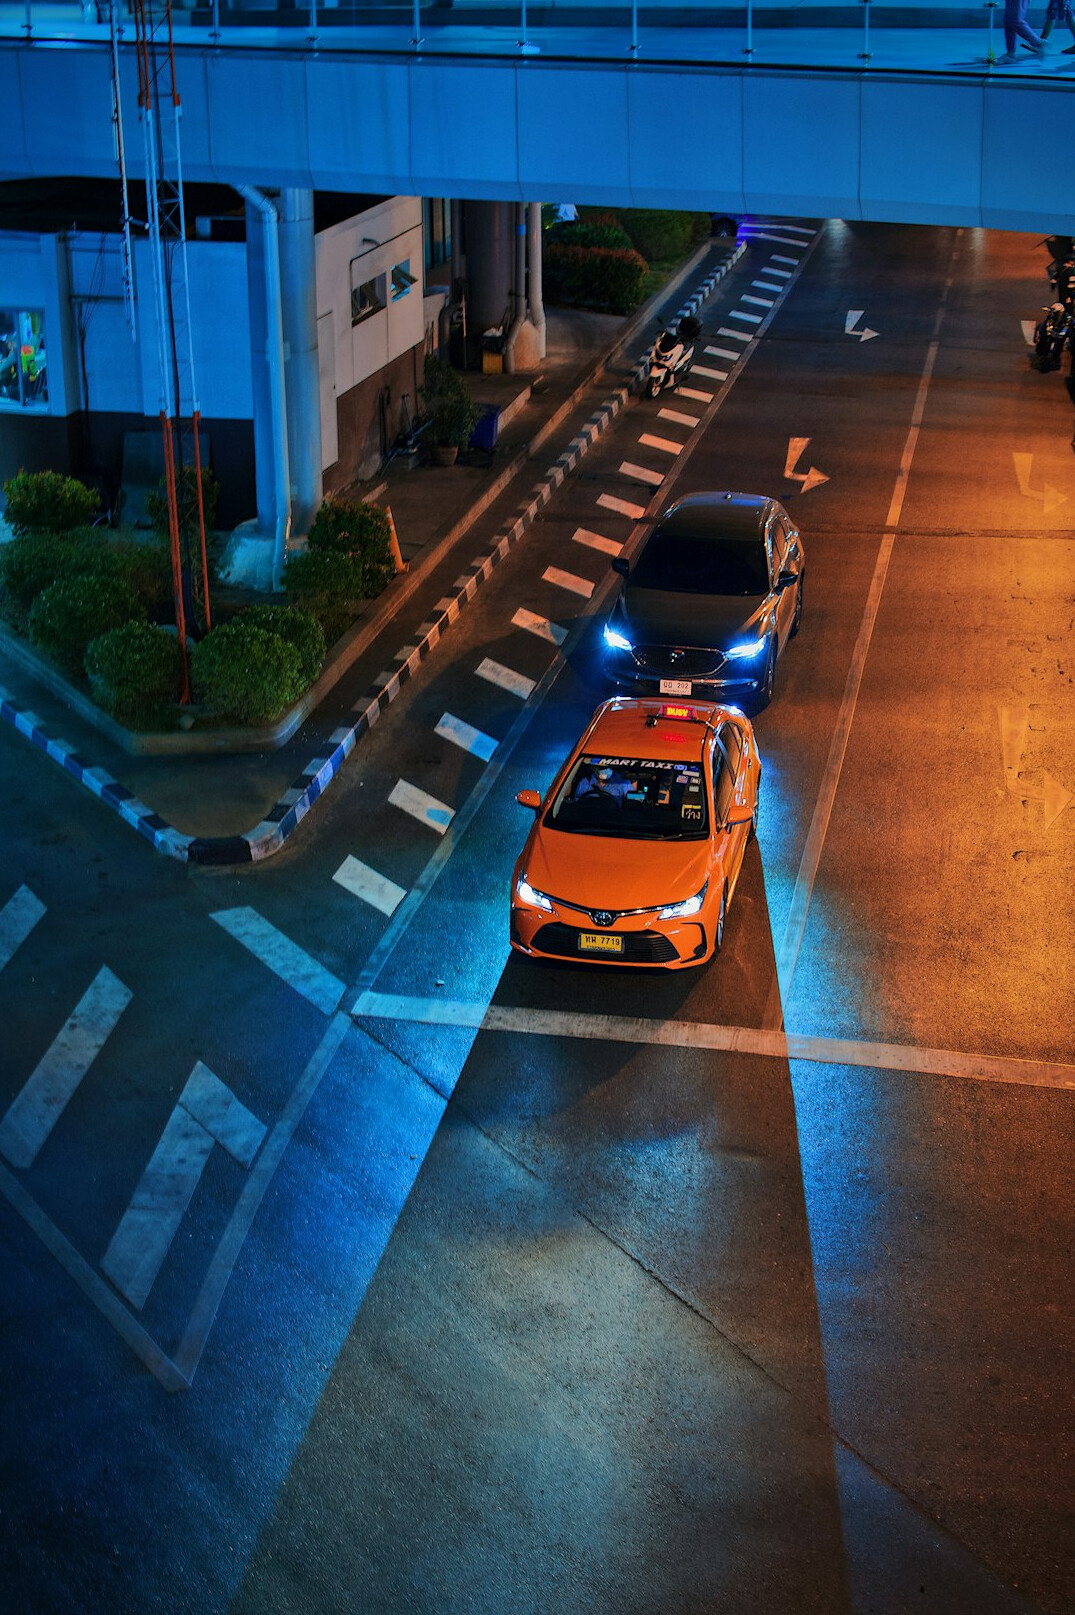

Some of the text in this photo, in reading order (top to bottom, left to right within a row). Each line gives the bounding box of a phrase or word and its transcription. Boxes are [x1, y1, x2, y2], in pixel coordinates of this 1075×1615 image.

[666, 707, 688, 717] BUSY
[597, 758, 674, 769] MART TAXI
[685, 809, 701, 820] ว่าง
[601, 937, 620, 945] 7719
